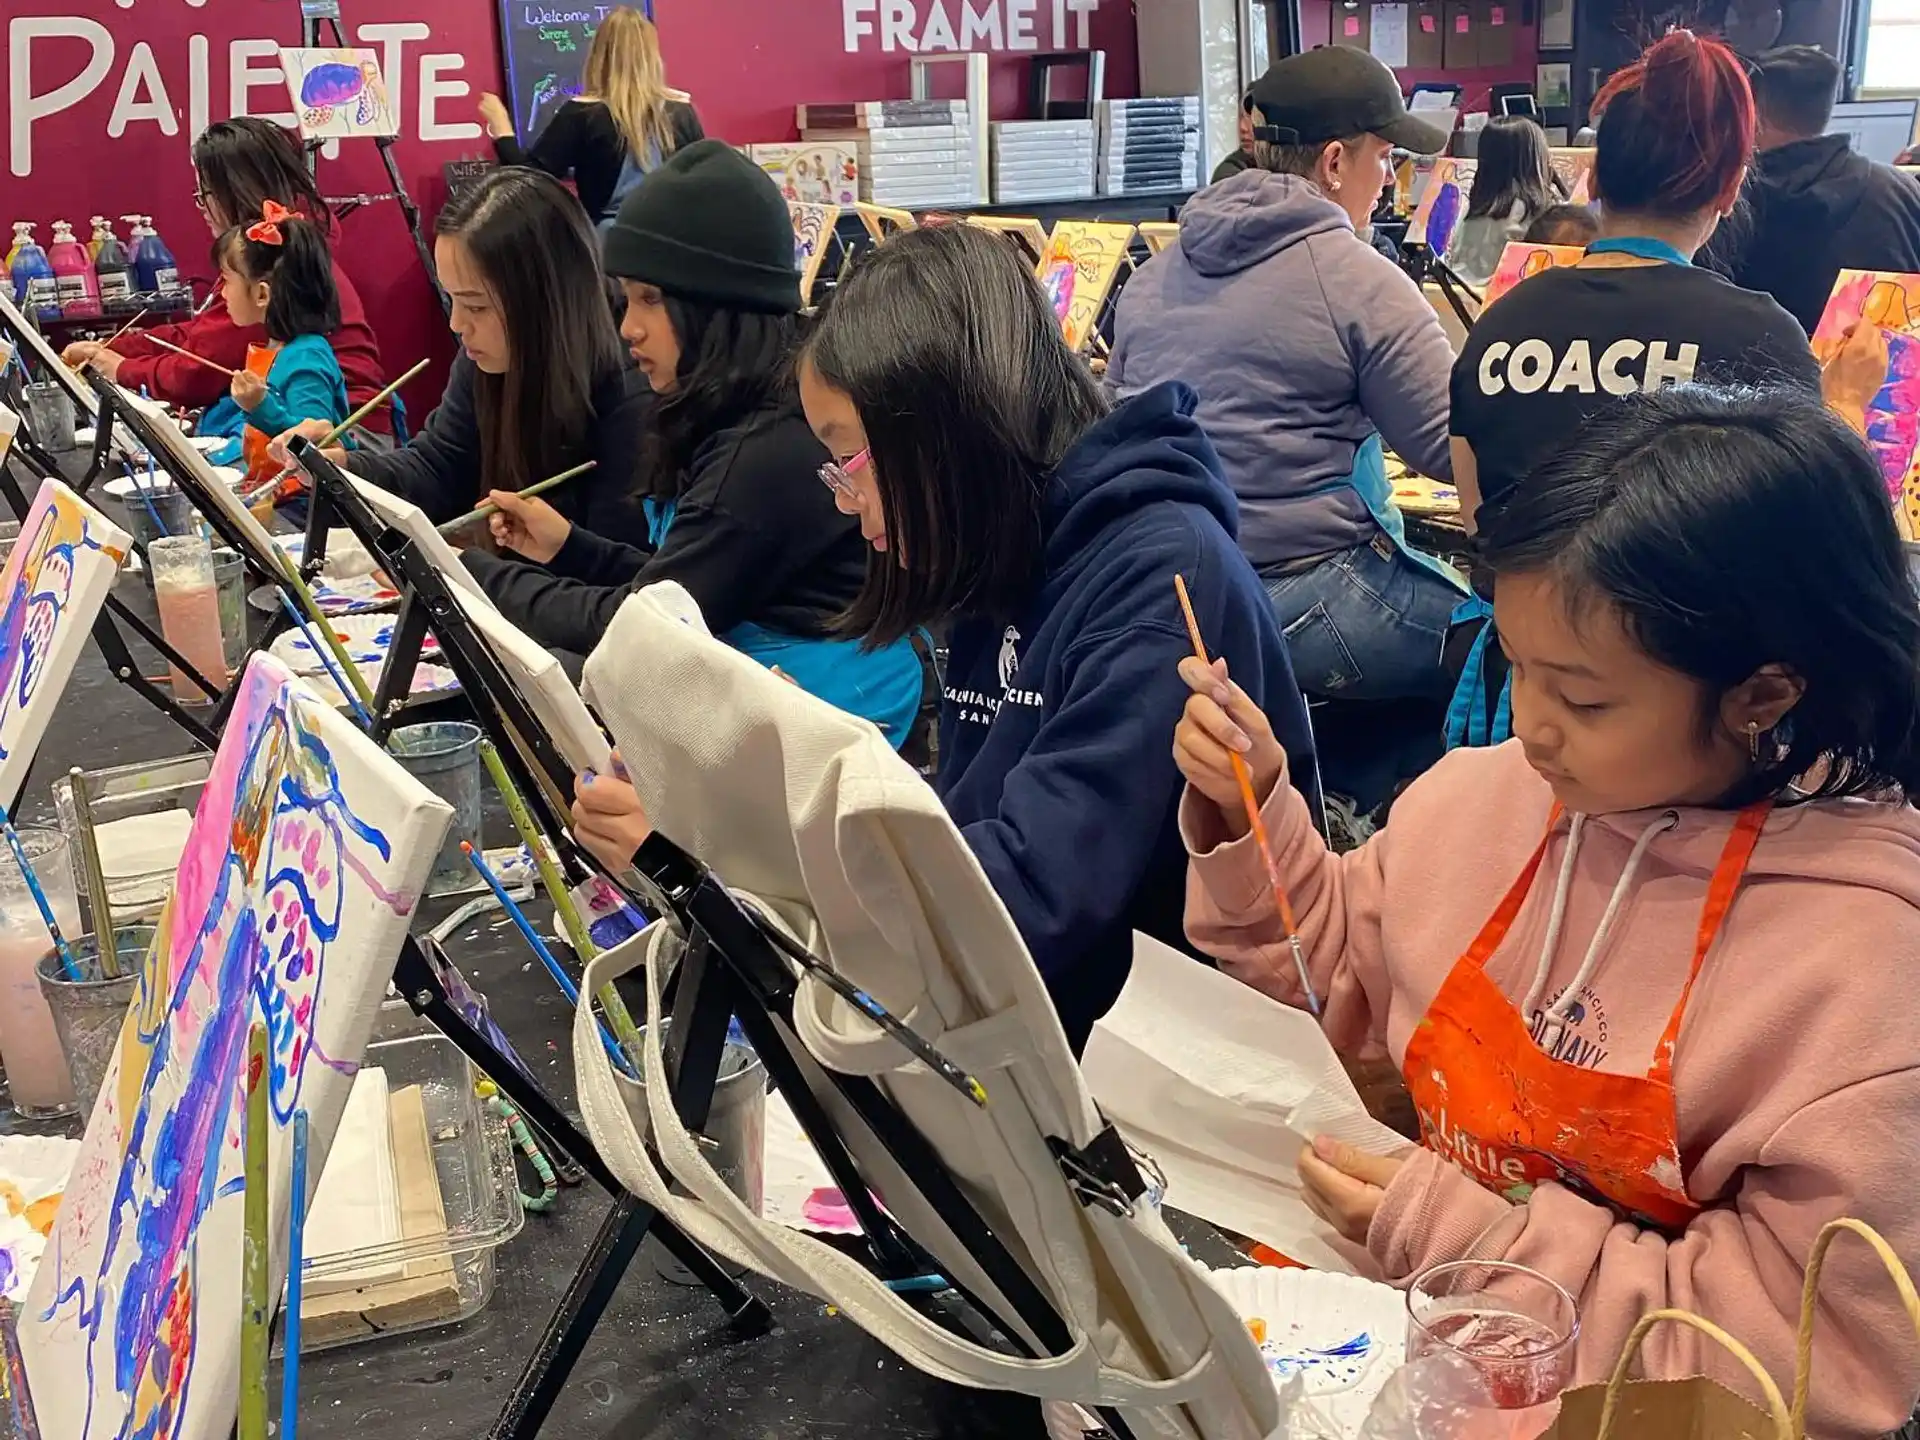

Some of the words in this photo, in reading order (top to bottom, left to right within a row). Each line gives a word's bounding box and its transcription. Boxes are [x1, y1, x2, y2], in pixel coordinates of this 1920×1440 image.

[525, 6, 590, 25] Welcome
[842, 0, 1038, 52] FRAME
[1052, 0, 1100, 49] IT
[9, 16, 482, 177] PALETE
[1478, 338, 1700, 395] COACH
[1550, 1022, 1608, 1070] NAVY
[1440, 1107, 1526, 1182] Little
